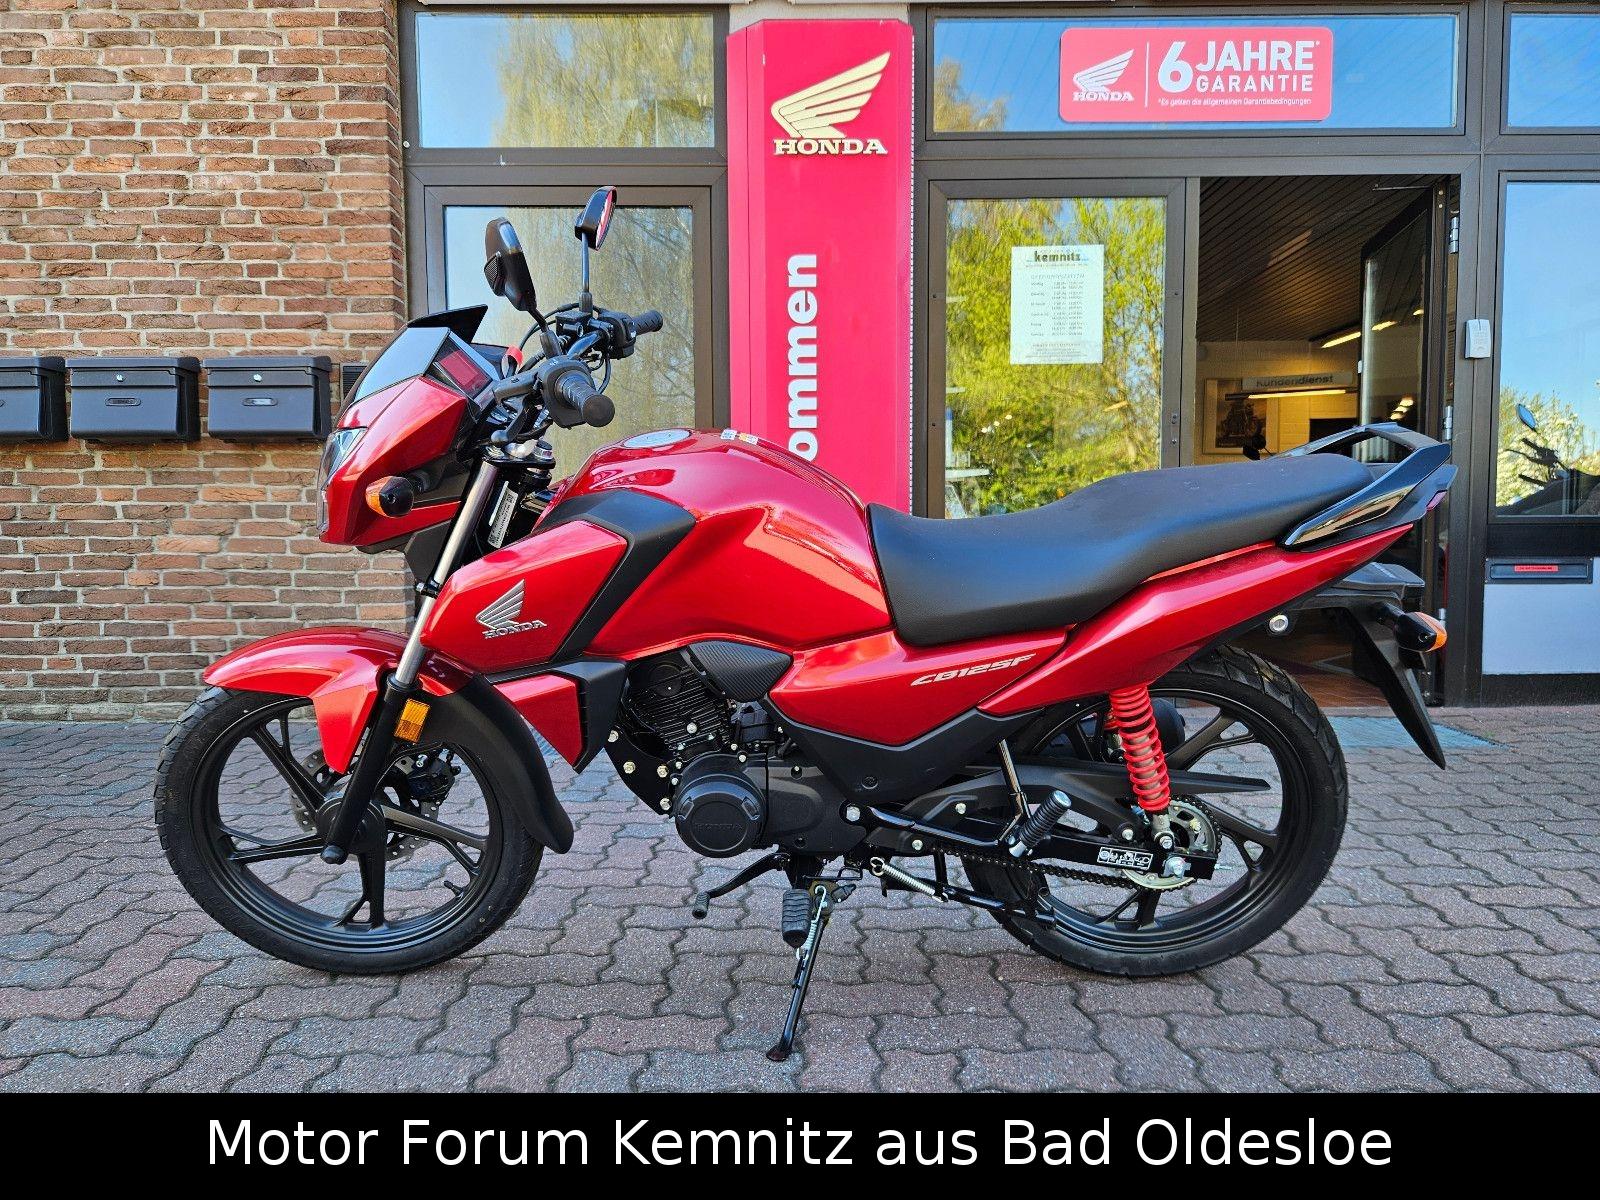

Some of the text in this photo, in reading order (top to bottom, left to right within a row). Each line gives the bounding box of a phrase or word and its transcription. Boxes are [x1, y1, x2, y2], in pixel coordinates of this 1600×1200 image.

[1157, 41, 1194, 93] 6
[1196, 75, 1313, 92] GARANTIE
[1072, 91, 1135, 101] HONDA
[773, 138, 888, 156] HONDA
[1034, 250, 1081, 262] kemnitz
[482, 619, 547, 639] HONDA
[910, 653, 1037, 687] CB125F
